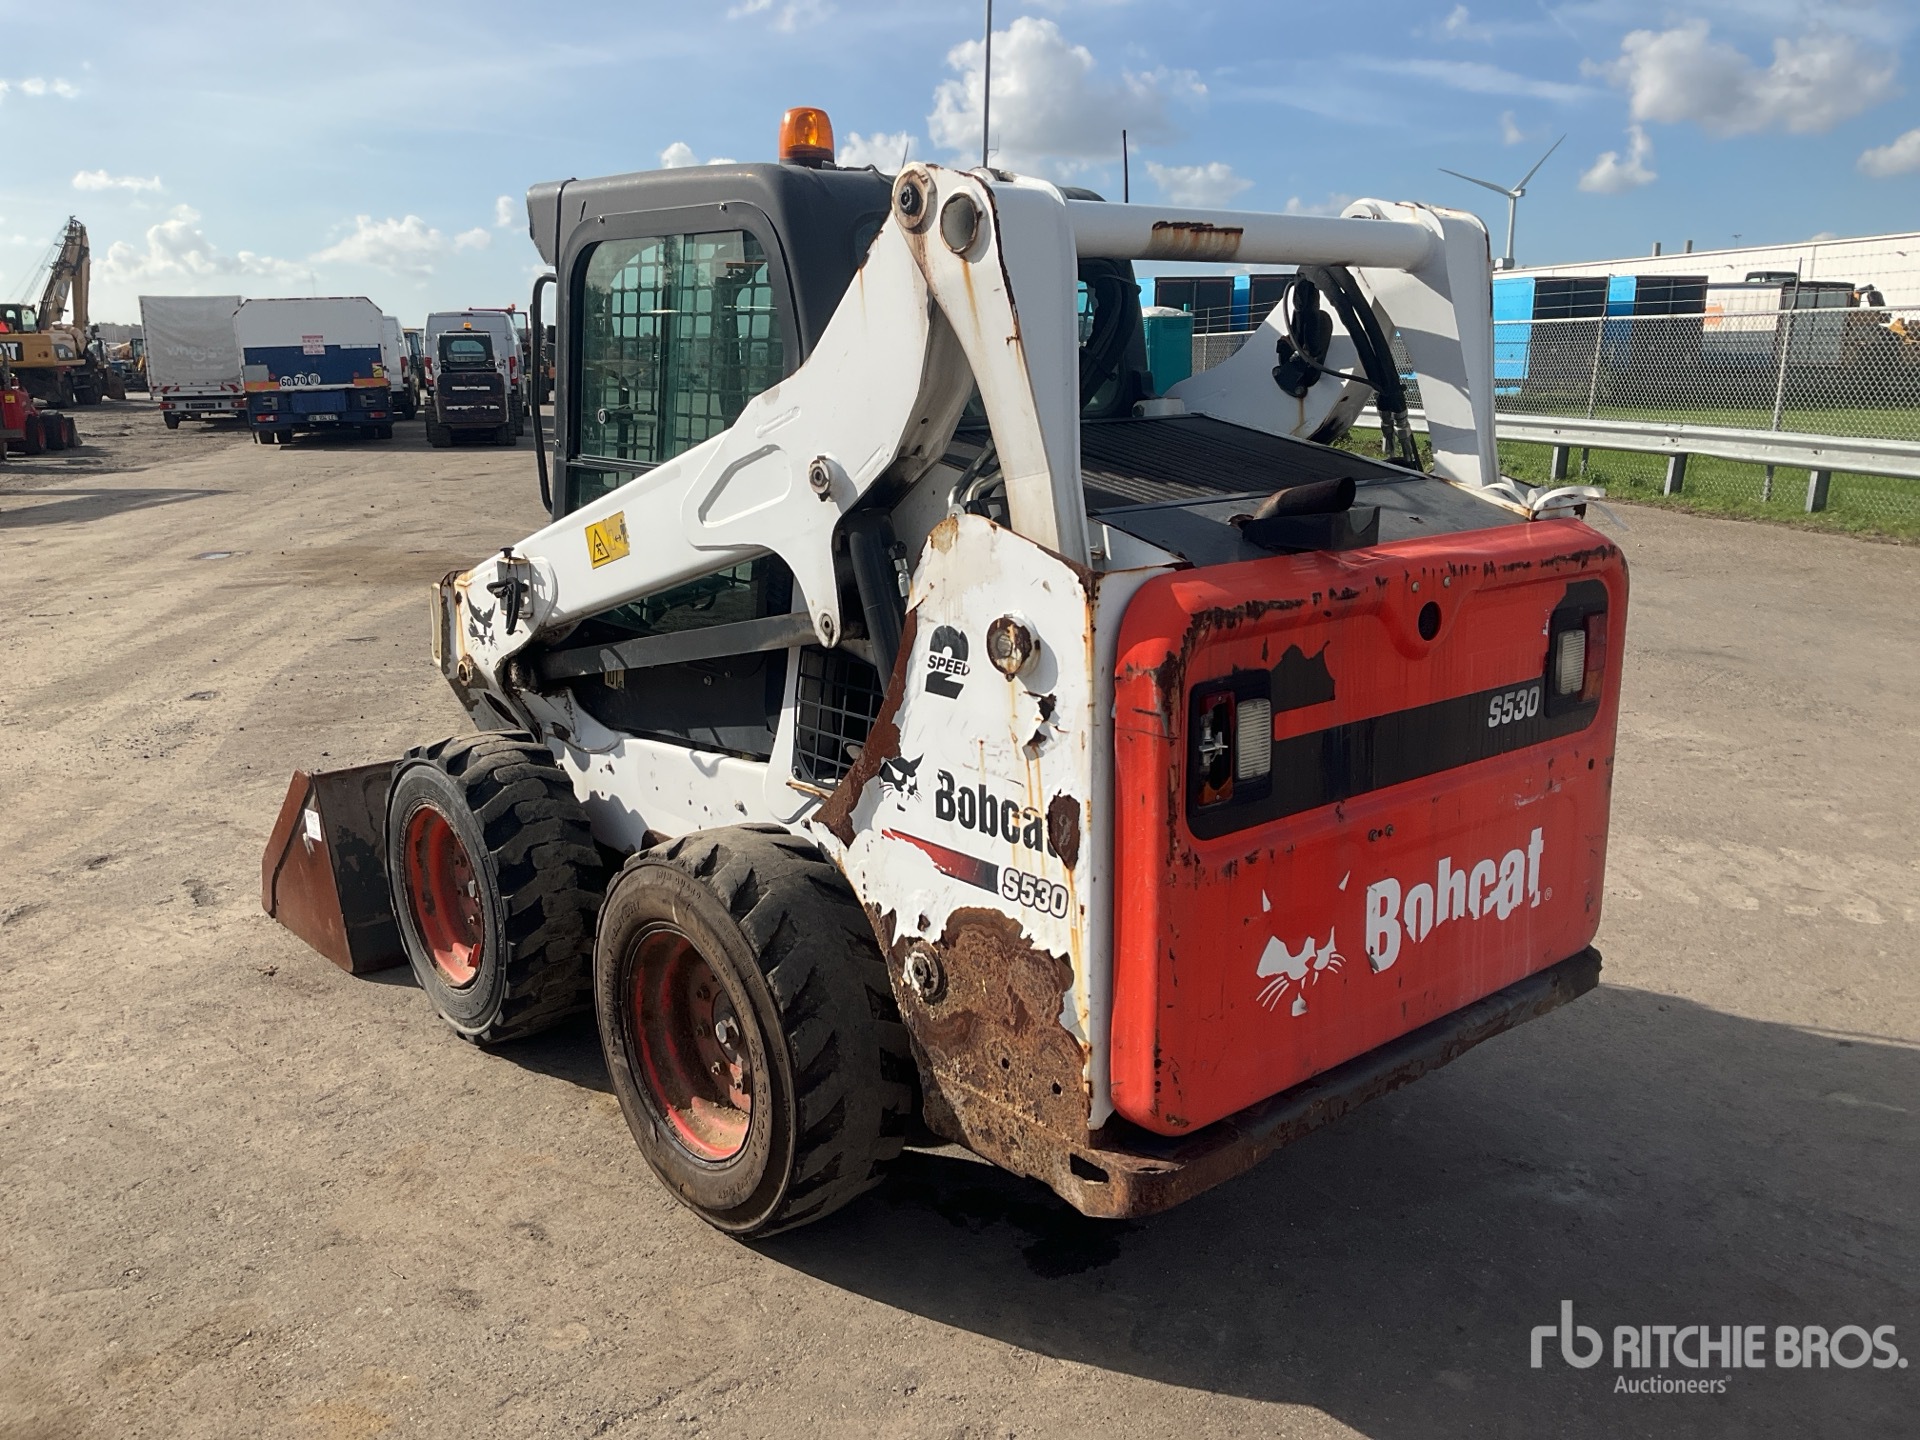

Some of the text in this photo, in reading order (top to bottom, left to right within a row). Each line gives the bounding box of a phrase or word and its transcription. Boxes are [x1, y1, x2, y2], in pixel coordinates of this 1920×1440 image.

[0, 342, 18, 361] AT
[281, 375, 319, 387] 60 70 80
[925, 625, 970, 700] 2
[927, 654, 971, 677] SPEED
[1487, 685, 1540, 729] S530
[1001, 867, 1070, 919] S530
